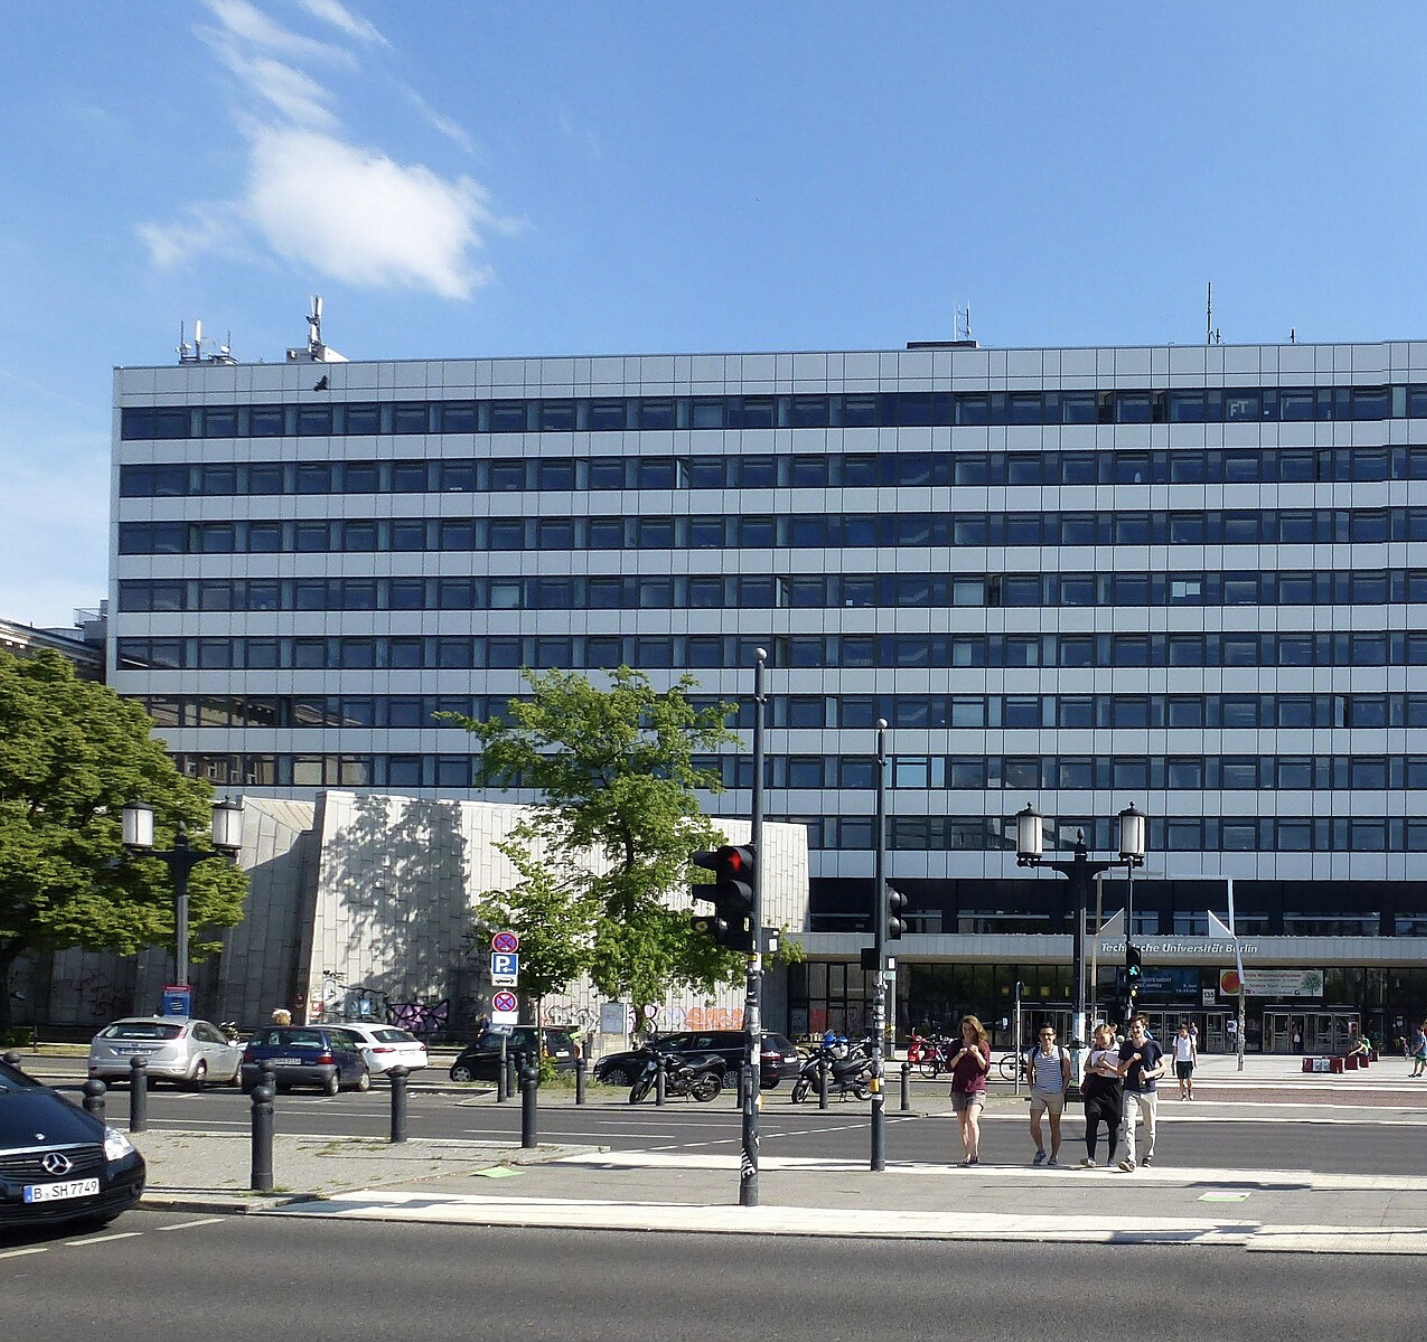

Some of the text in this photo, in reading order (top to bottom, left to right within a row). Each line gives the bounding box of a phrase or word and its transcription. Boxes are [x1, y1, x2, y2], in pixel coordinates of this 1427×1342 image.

[1101, 942, 1160, 953] Techche
[1162, 942, 1224, 953] Universität
[495, 955, 511, 973] P
[34, 1188, 42, 1199] B
[52, 1185, 67, 1197] SH
